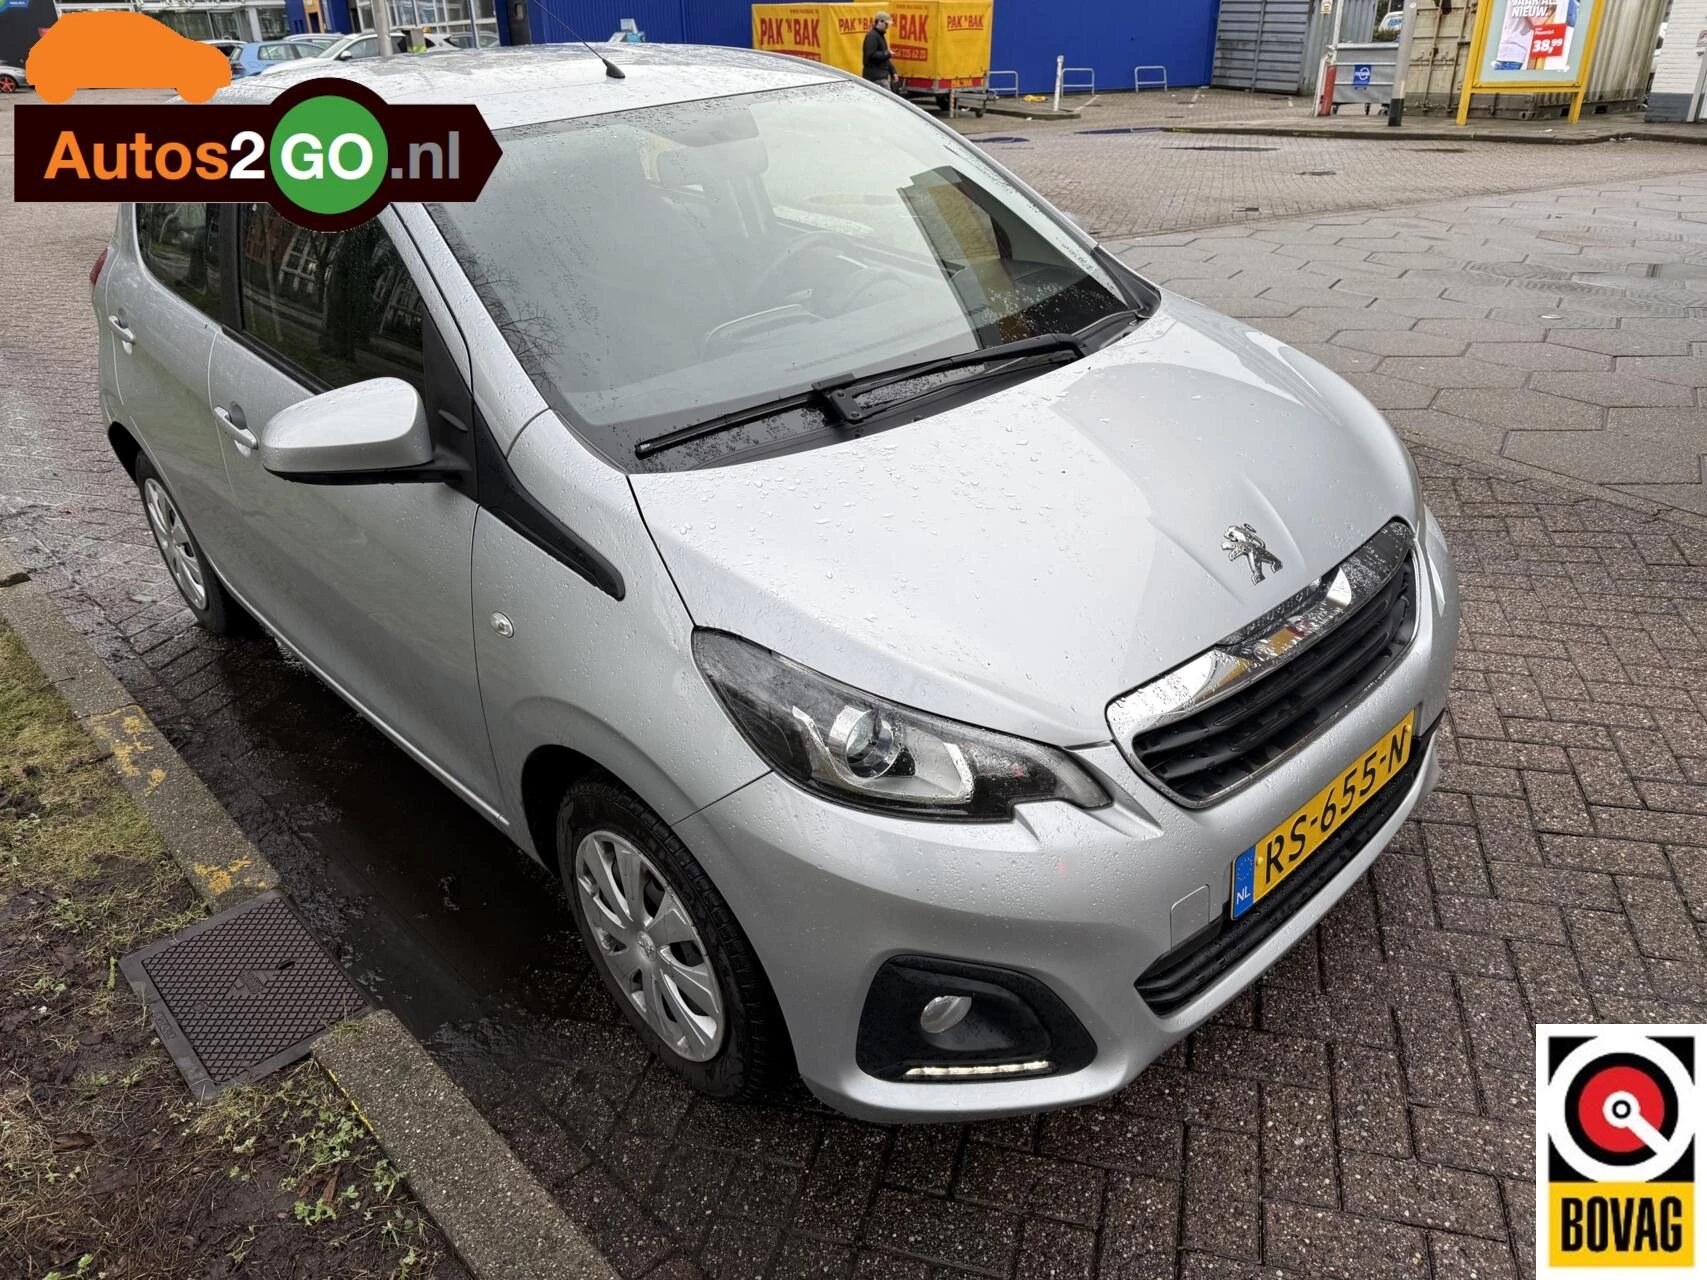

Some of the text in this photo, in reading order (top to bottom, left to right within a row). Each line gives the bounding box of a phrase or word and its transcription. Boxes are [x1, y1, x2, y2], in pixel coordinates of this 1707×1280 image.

[760, 17, 784, 46] PAK
[794, 18, 820, 48] BAK
[839, 18, 856, 31] PAK
[899, 14, 928, 43] BAK
[947, 16, 962, 28] PAK
[968, 15, 984, 27] BAK
[1265, 724, 1407, 885] RS-655-N
[1236, 886, 1250, 905] NL
